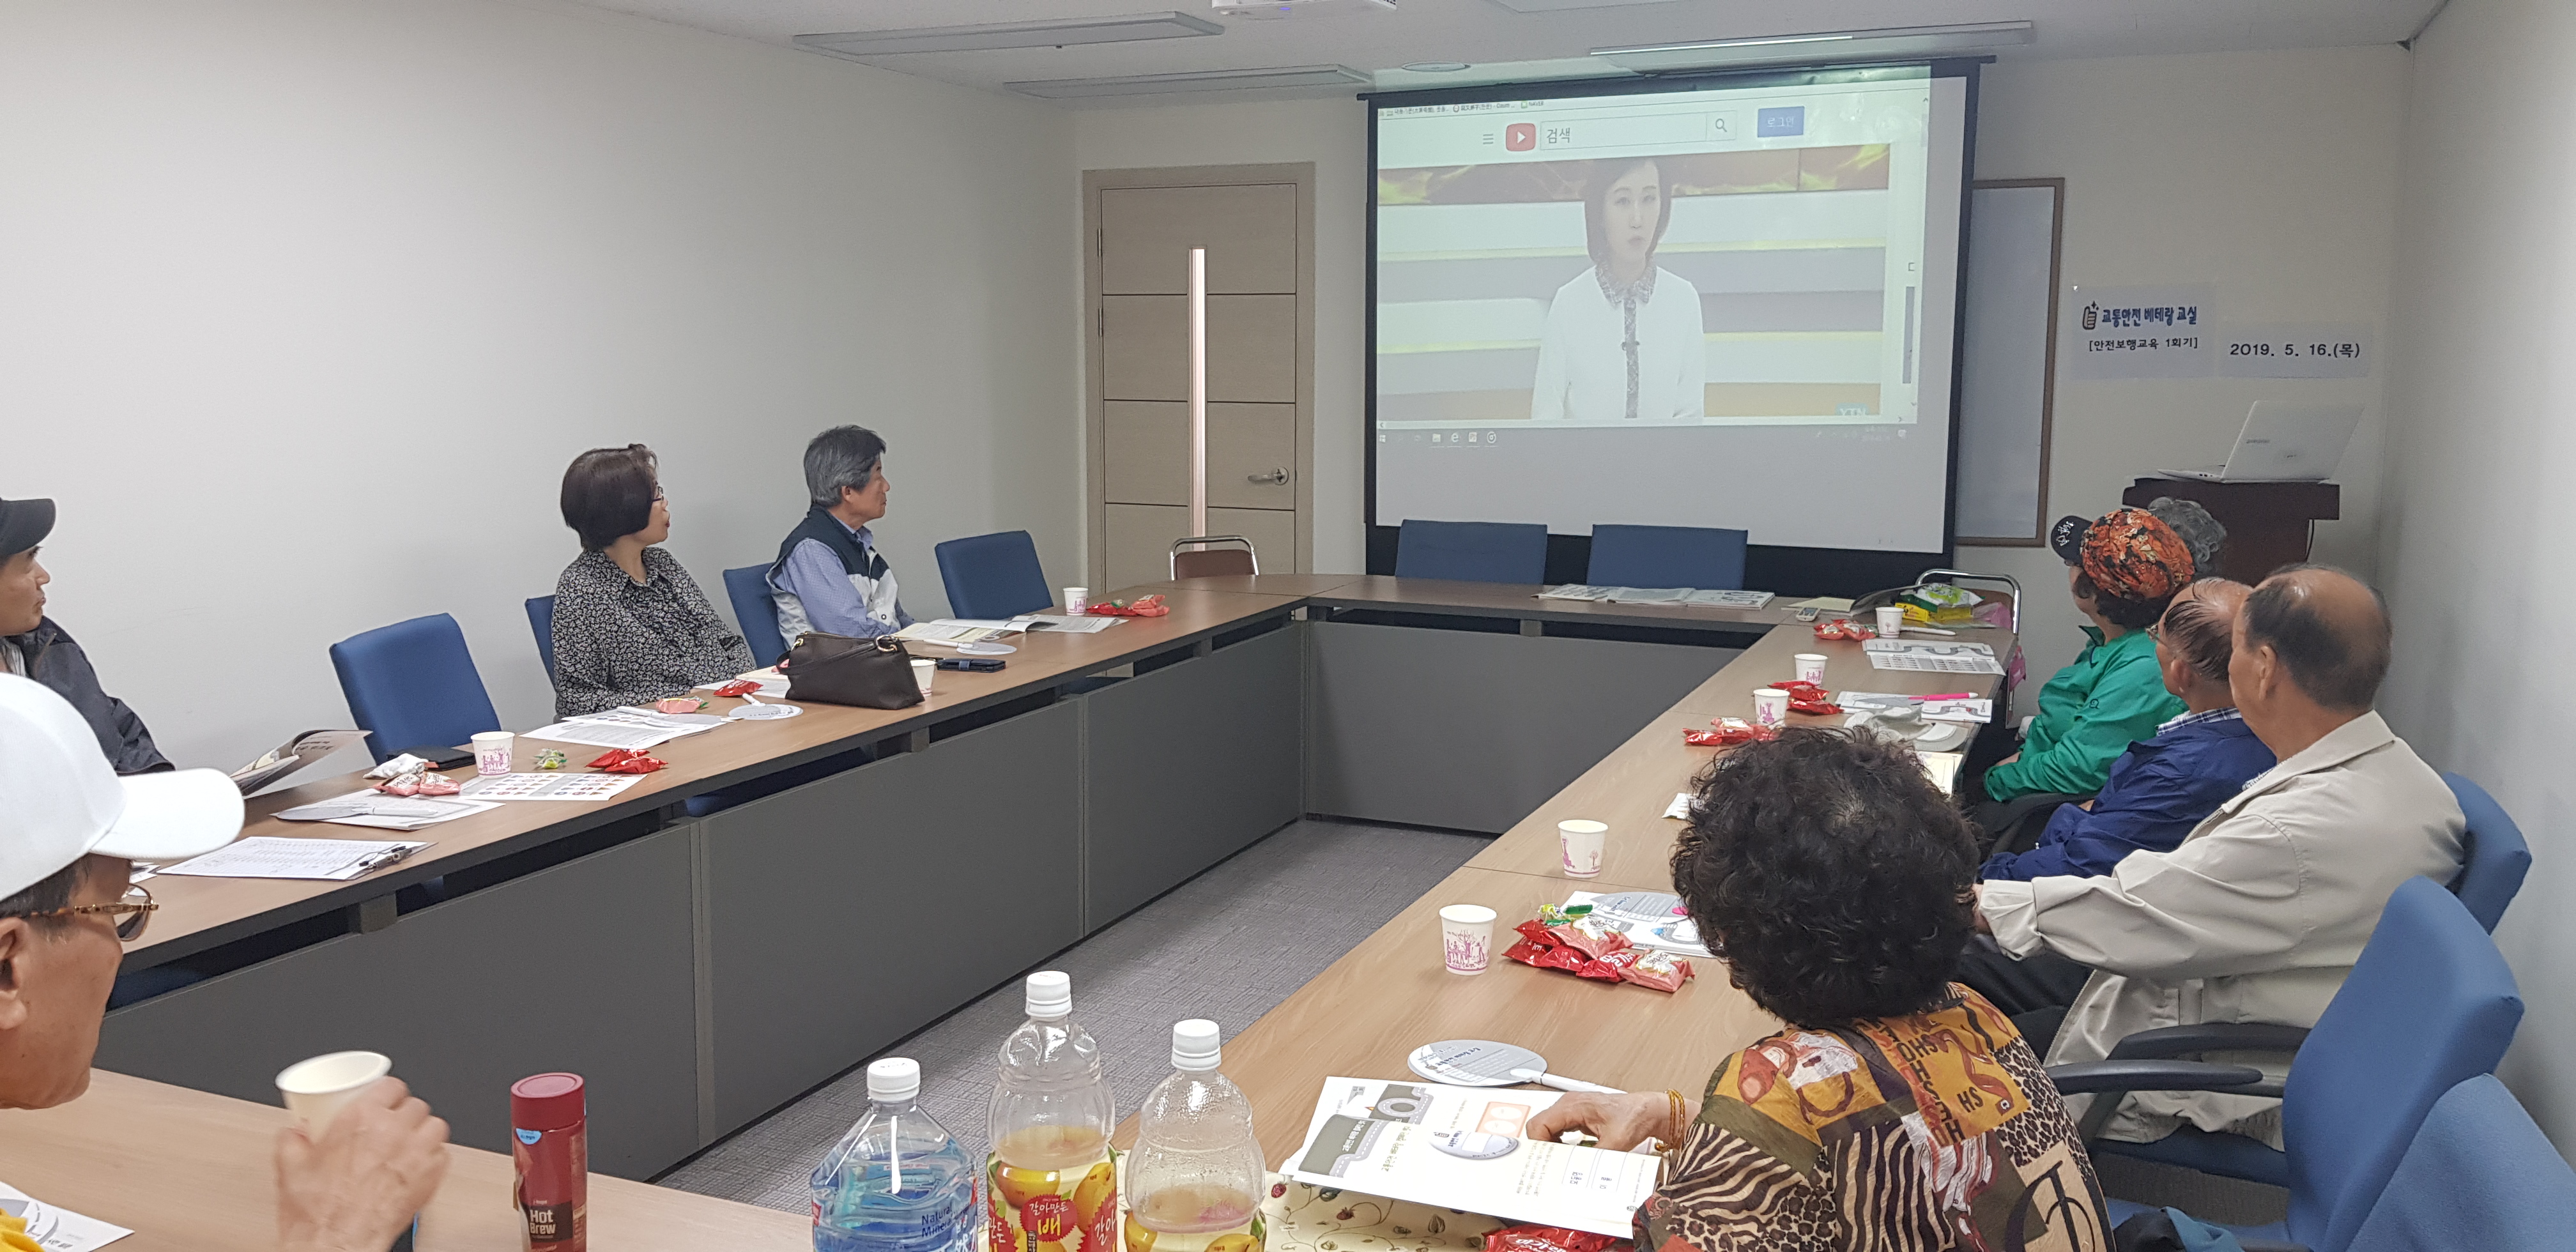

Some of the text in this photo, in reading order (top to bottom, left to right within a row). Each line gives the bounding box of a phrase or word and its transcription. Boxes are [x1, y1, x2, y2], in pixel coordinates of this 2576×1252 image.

[1767, 116, 1795, 128] 로그인
[1547, 128, 1570, 144] 검색
[2101, 305, 2197, 328] 교통안전 베테랑 교실
[2089, 337, 2198, 352] [안전보행교육 1회기]
[2230, 343, 2274, 356] 2019.
[2285, 344, 2299, 356] 5.
[922, 1202, 952, 1225] Natural
[1029, 1201, 1068, 1216] 갈아만든
[530, 1210, 554, 1223] Hot
[530, 1223, 556, 1235] Brew
[1038, 1214, 1061, 1236] 배
